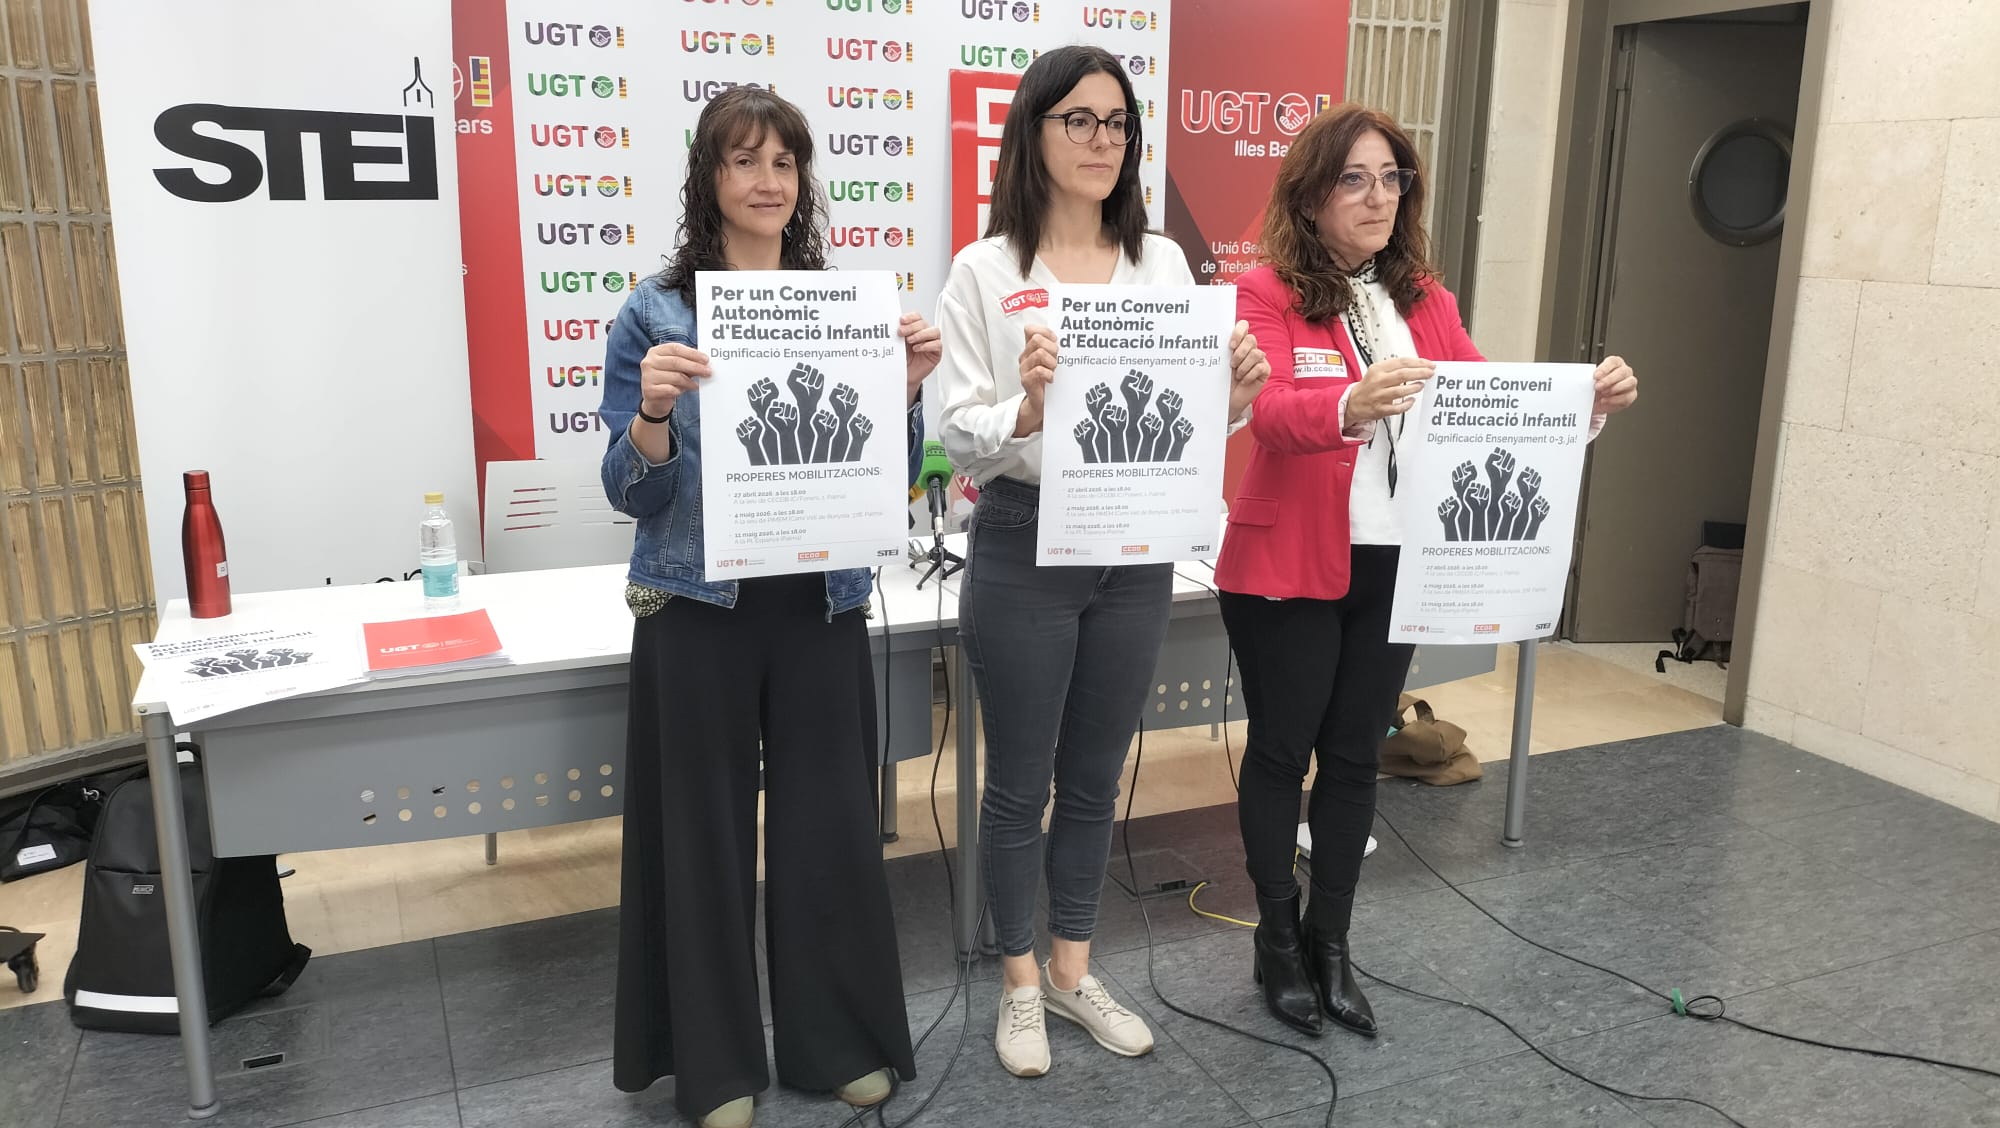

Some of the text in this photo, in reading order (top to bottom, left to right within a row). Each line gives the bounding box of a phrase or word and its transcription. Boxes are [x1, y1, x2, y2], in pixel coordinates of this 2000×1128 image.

[962, 0, 1008, 20] UGT
[1084, 6, 1126, 29] UGT
[525, 22, 583, 46] UGT
[681, 30, 736, 54] UGT
[827, 37, 878, 61] UGT
[961, 45, 1007, 67] UGT
[528, 73, 585, 97] UGT
[828, 86, 878, 109] UGT
[1181, 89, 1270, 134] UGT
[531, 124, 588, 147] UGT
[829, 134, 879, 155] UGT
[1235, 140, 1265, 157] Illes
[152, 103, 439, 203] STEI
[535, 174, 591, 197] UGT
[830, 181, 879, 202] UGT
[538, 223, 594, 245] UGT
[831, 227, 879, 247] UGT
[1212, 241, 1239, 254] Unió
[1201, 260, 1216, 273] de
[541, 272, 597, 293] UGT
[711, 286, 857, 301] Per un Conveni
[1003, 295, 1026, 309] UGT
[1062, 298, 1190, 314] Per un Conveni
[711, 305, 820, 320] Autonòmic
[544, 319, 599, 341] UGT
[1061, 316, 1154, 331] Autonòmic
[712, 324, 890, 340] d'Educació Infantil
[1060, 334, 1219, 349] d'Educació Infantil
[711, 348, 780, 359] Dignificació
[784, 347, 859, 360] Ensenyament
[882, 347, 894, 359] ja!
[1057, 355, 1117, 366] Dignificació
[1120, 356, 1187, 368] Ensenyament
[1208, 356, 1221, 368] ja!
[547, 366, 602, 387] UGT
[1436, 376, 1552, 391] Per un Conveni
[1433, 394, 1519, 408] Autonòmic
[1431, 411, 1576, 427] d'Educació Infantil
[1427, 433, 1483, 444] Dignificació
[1486, 433, 1547, 445] Ensenyament
[1566, 434, 1578, 445] ja!
[726, 467, 883, 482] PROPERES MOBILITZACIONS:
[1062, 467, 1200, 479] PROPERES MOBILITZACIONS:
[739, 512, 755, 520] maig
[742, 532, 758, 540] maig
[1422, 546, 1551, 556] PROPERES MOBILITZACIONS:
[380, 644, 420, 654] UGT
